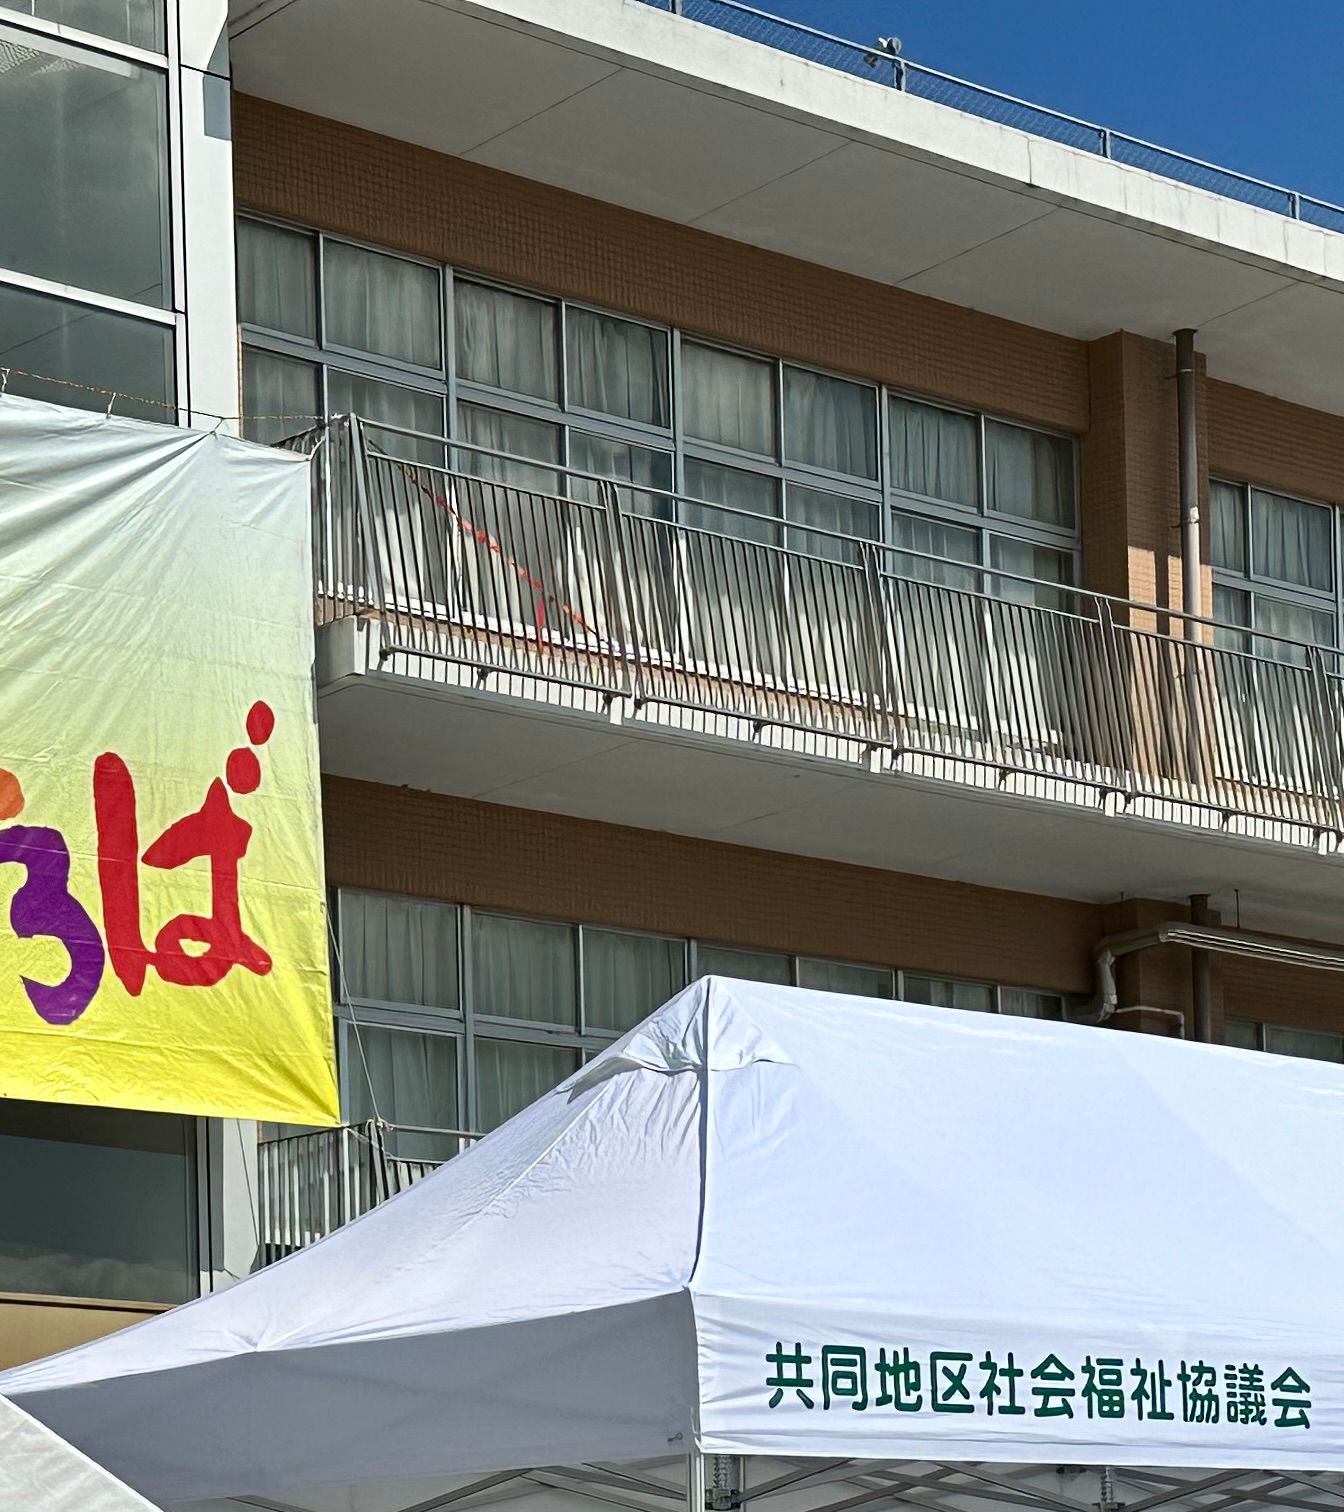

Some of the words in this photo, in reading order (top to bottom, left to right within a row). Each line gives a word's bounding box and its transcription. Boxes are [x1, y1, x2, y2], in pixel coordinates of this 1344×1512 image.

[765, 1341, 1311, 1429] 共同地区社会福祉協議会
